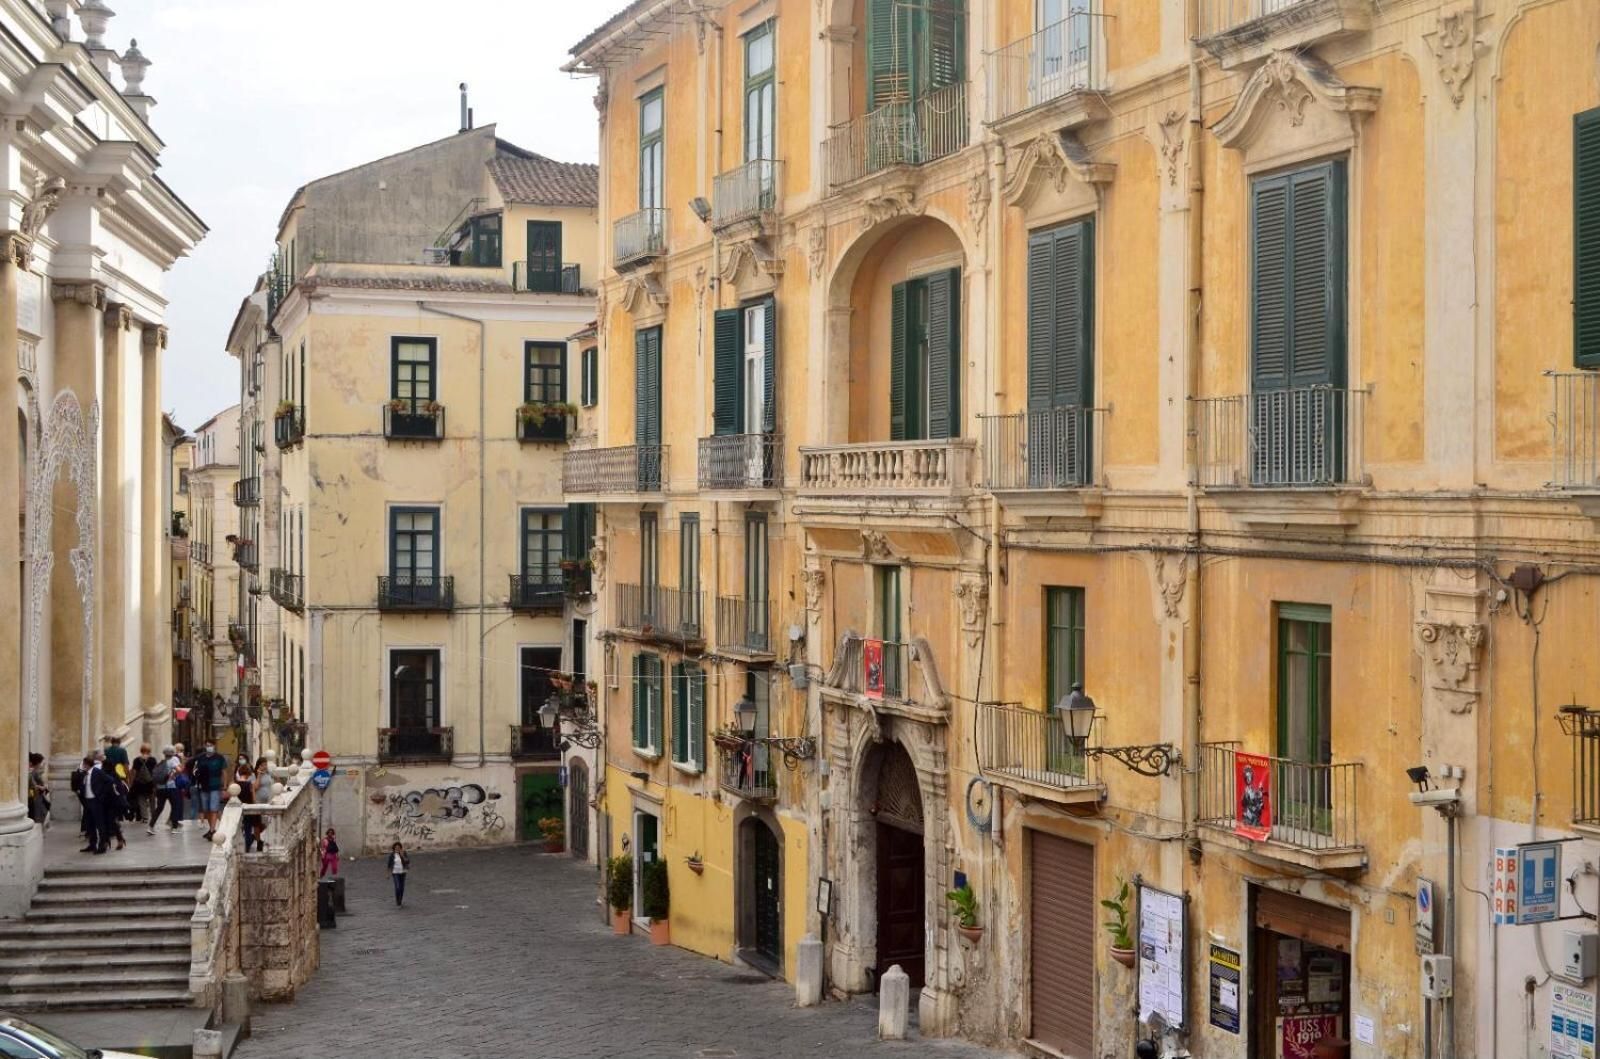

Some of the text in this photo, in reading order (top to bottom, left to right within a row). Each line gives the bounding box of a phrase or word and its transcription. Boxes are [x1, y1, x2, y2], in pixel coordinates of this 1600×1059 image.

[1495, 858, 1504, 912] BAR
[1506, 858, 1516, 913] BAR
[1299, 1019, 1320, 1032] USS
